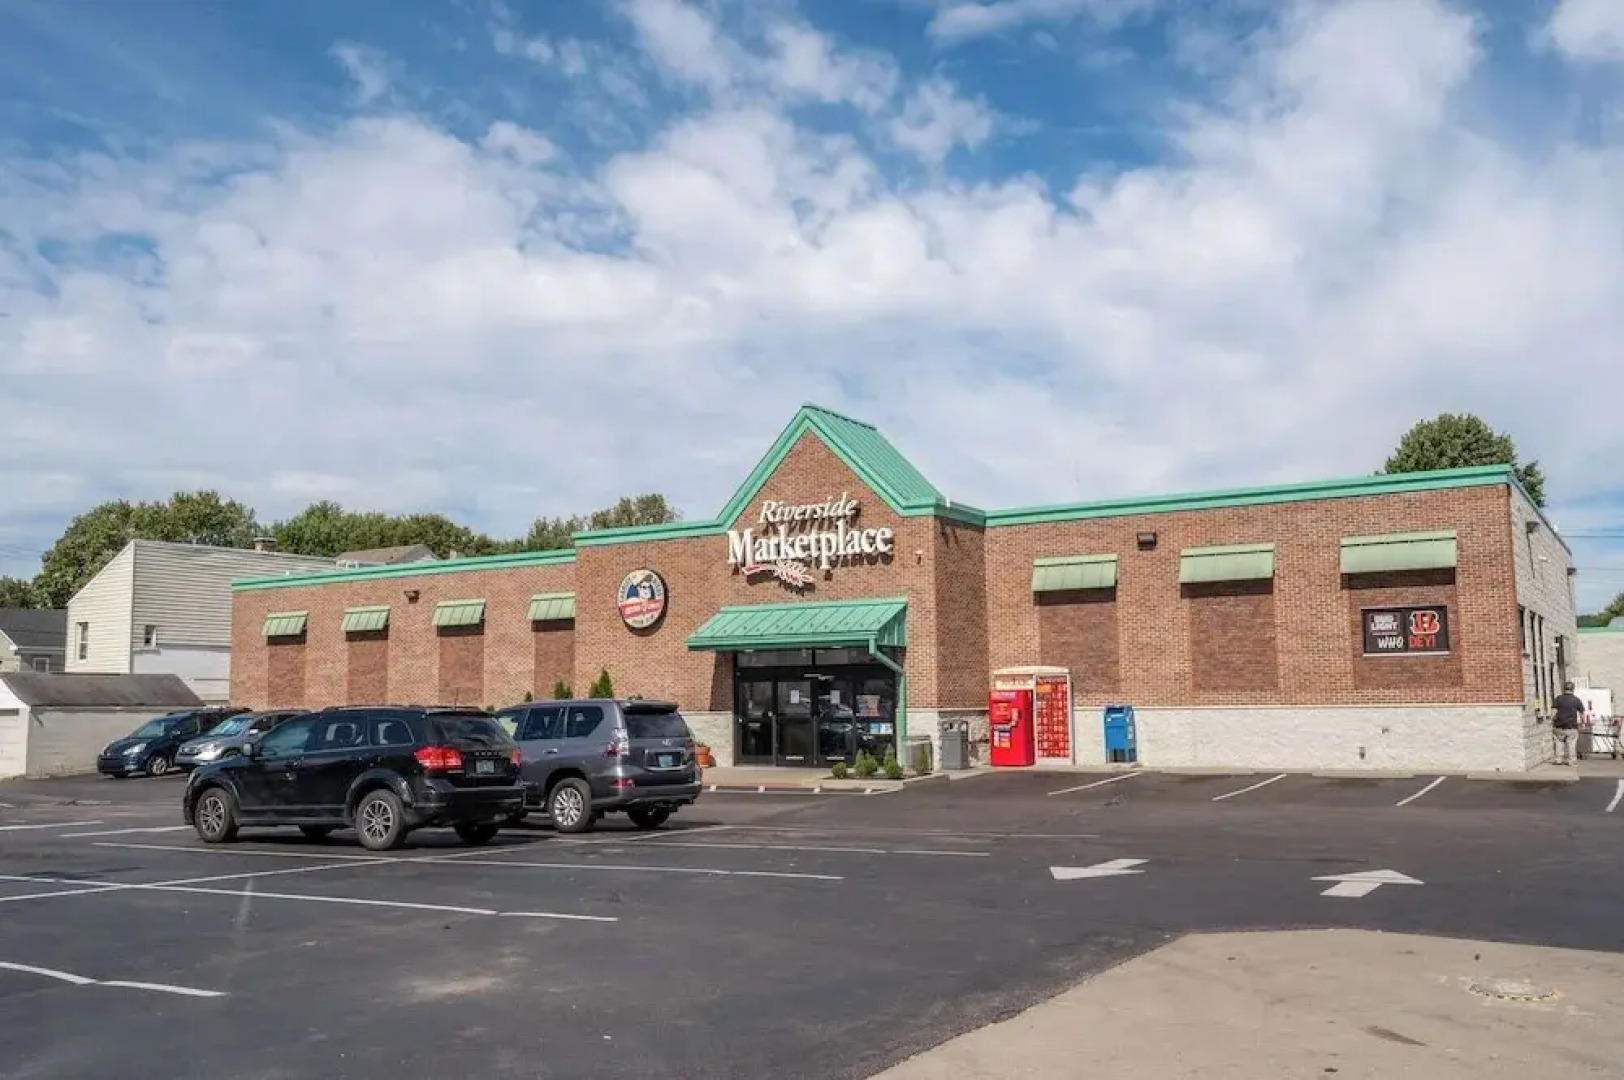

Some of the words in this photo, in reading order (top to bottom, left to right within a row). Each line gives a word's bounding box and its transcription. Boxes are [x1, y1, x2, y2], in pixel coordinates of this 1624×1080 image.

[757, 492, 859, 524] Riverside
[727, 518, 894, 570] Marketplace
[1377, 636, 1404, 649] WHO
[1408, 634, 1435, 649] DEY!
